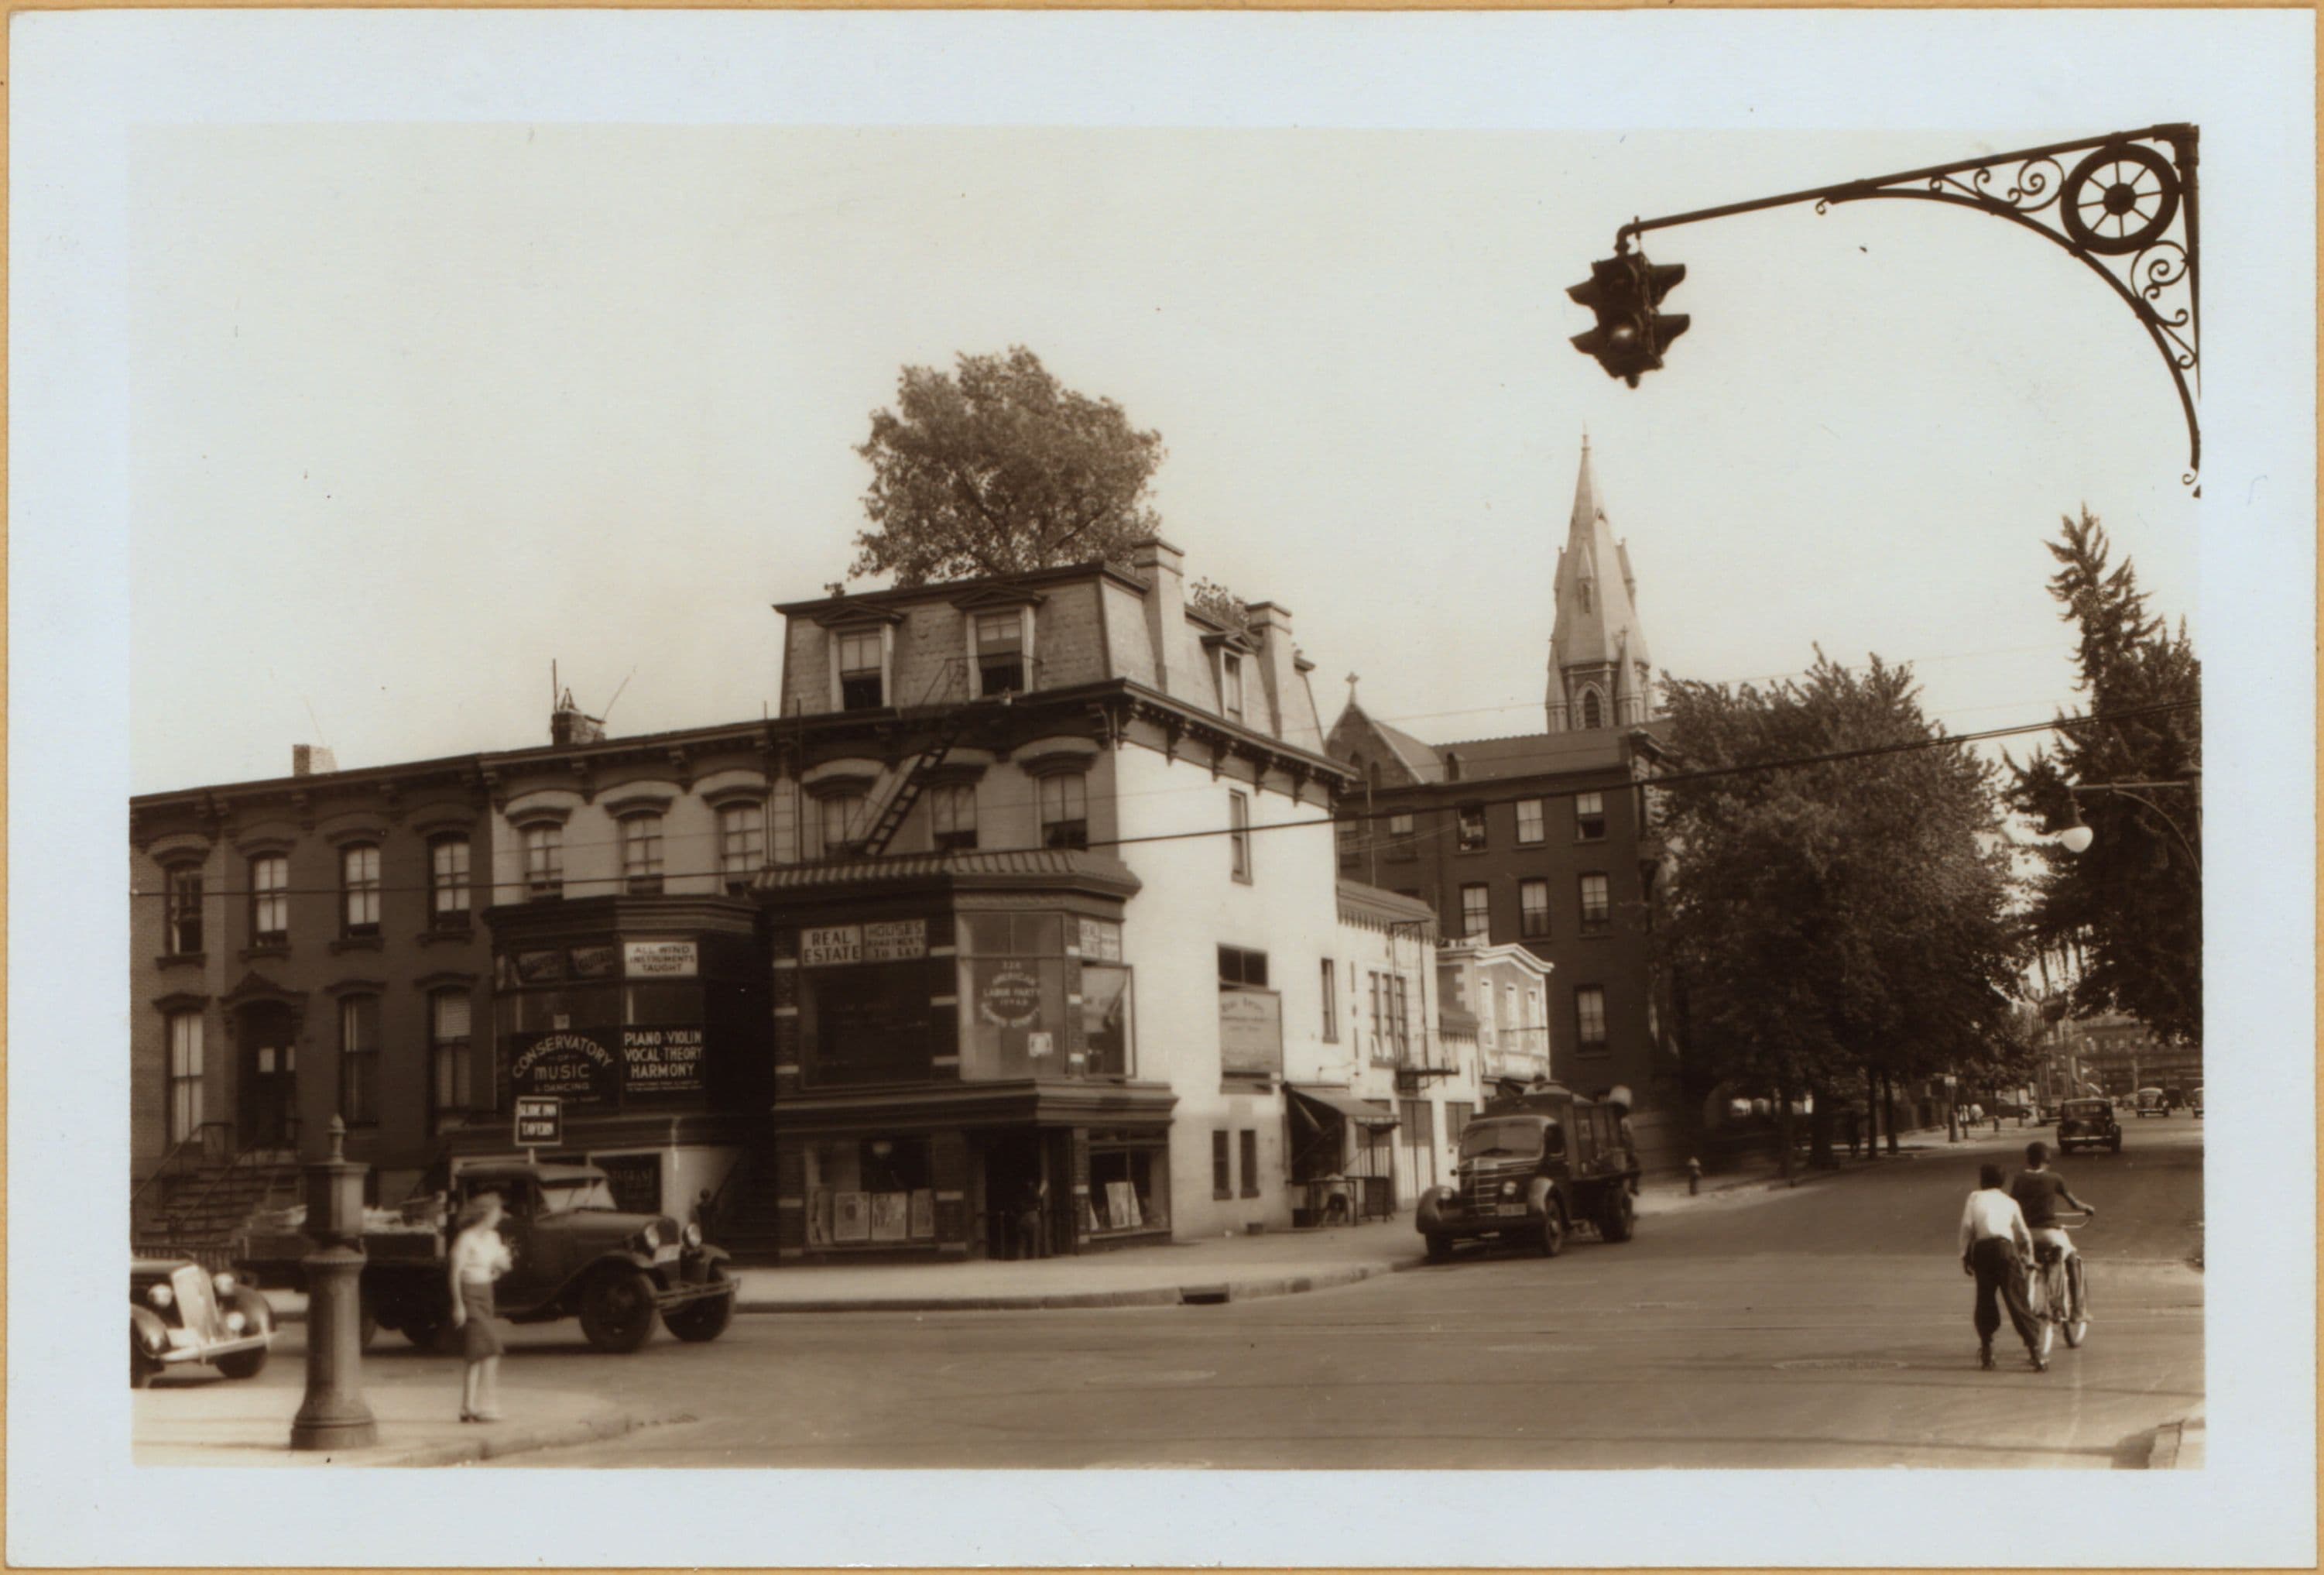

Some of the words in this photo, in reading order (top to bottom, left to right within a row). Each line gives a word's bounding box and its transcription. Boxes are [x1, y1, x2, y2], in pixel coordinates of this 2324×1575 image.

[812, 930, 852, 945] REAL
[630, 955, 694, 963] INSTRUMENTS
[804, 945, 861, 963] ESTATE
[643, 963, 682, 972] TAUGHT
[624, 1031, 662, 1045] PIANO
[666, 1031, 701, 1044] VIOLIN
[512, 1035, 613, 1078] CONSERVATORY
[625, 1048, 660, 1062] VOCAL
[663, 1046, 703, 1060] THEORY
[534, 1064, 589, 1080] MUSIC
[631, 1062, 694, 1078] HARMONY
[543, 1083, 590, 1092] DANCING
[543, 1103, 557, 1116] INN
[520, 1121, 554, 1136] TAVERN
